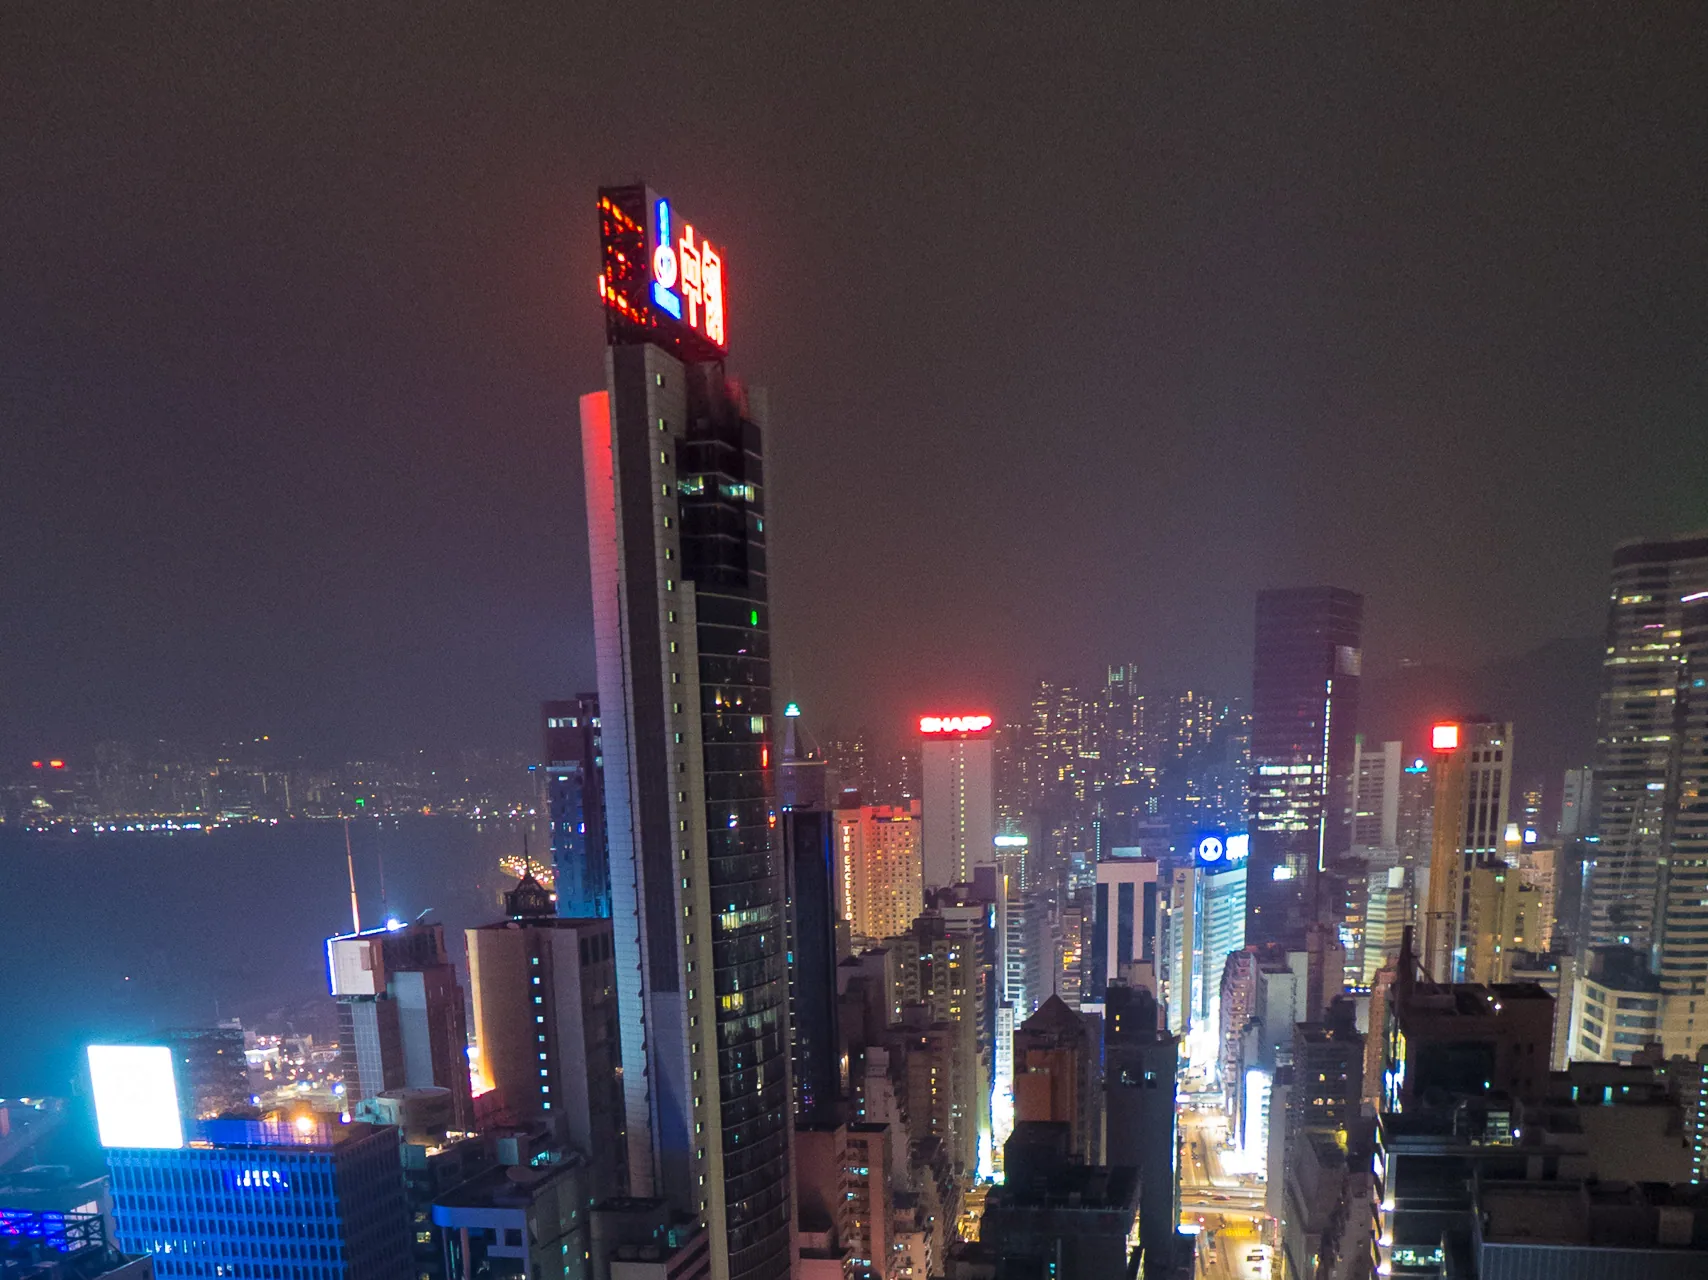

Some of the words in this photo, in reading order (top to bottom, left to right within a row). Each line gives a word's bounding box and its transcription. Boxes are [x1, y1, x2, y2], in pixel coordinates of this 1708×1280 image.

[919, 715, 993, 733] SHARP
[843, 826, 851, 852] THE
[844, 855, 853, 921] EXCELSIO
